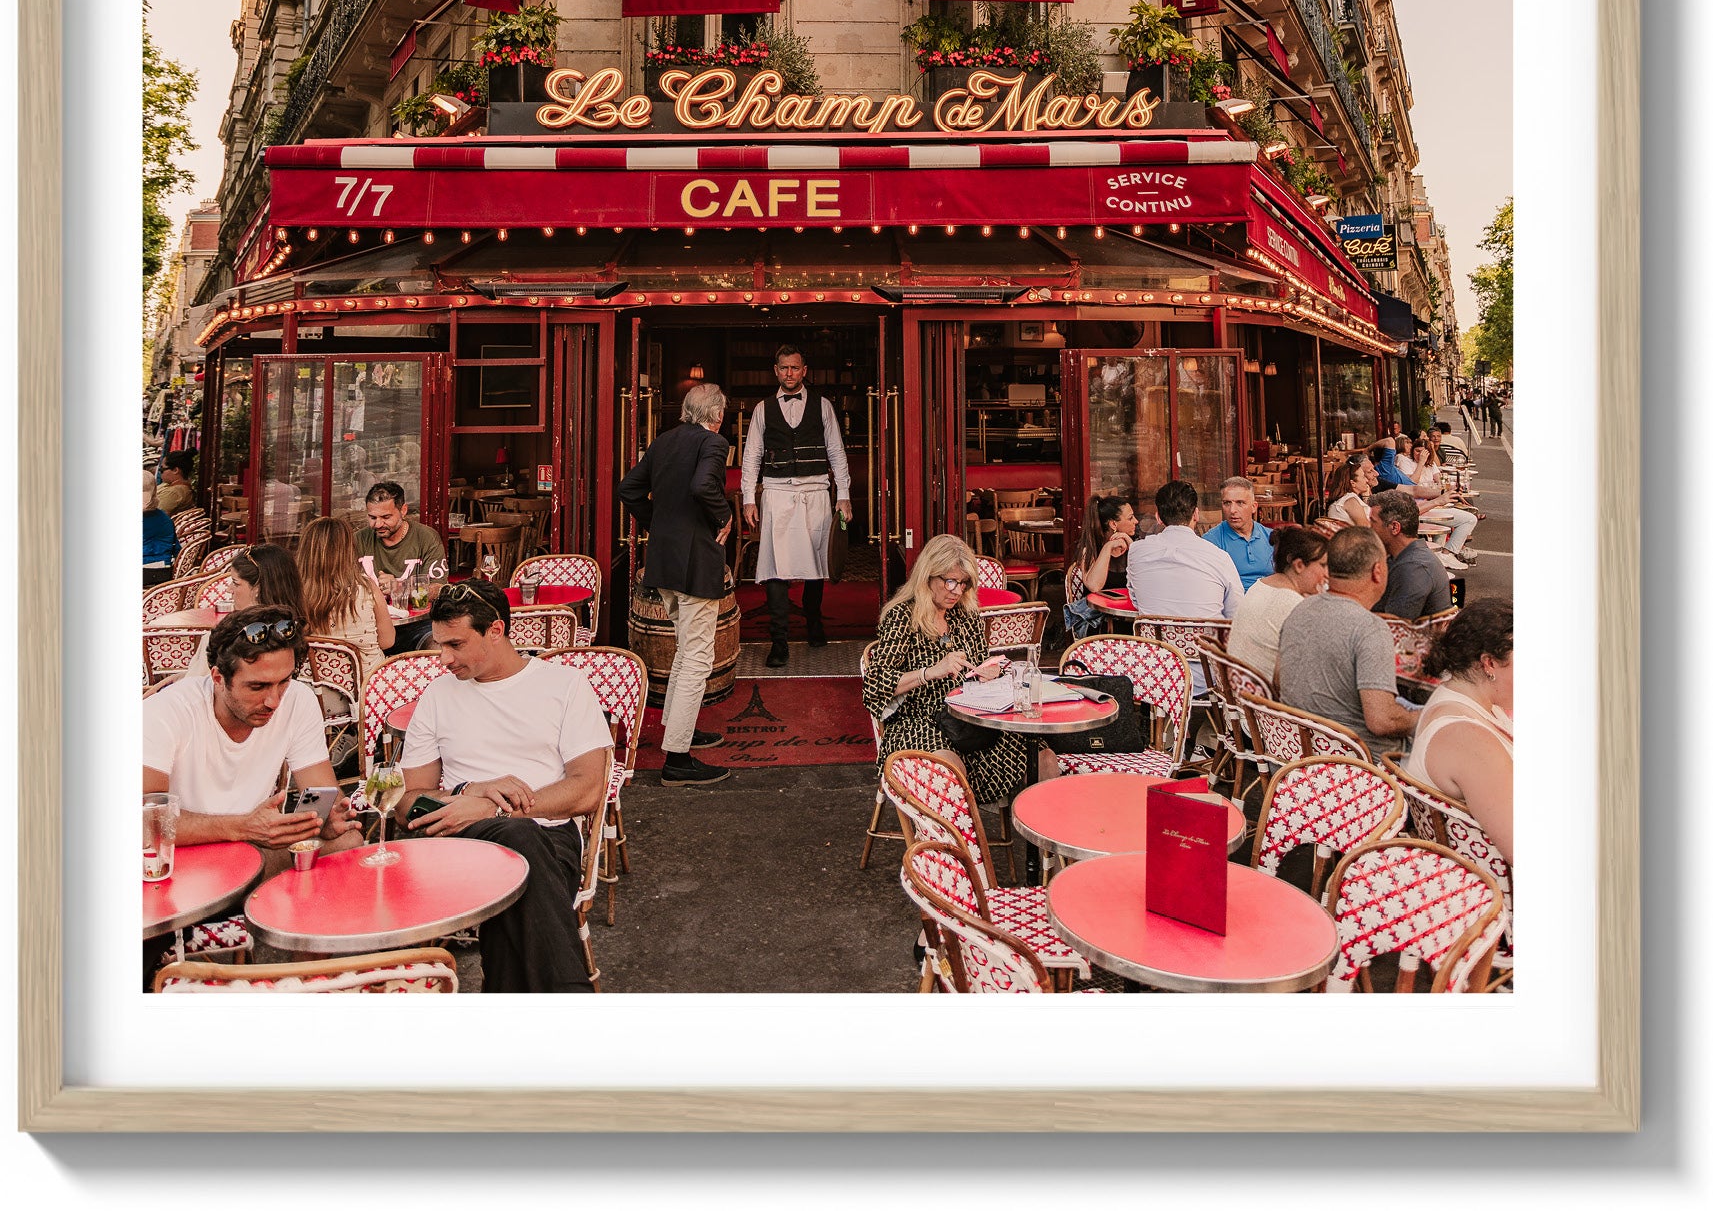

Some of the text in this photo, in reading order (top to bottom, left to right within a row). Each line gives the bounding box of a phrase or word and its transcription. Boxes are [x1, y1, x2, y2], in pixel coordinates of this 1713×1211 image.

[535, 67, 1161, 133] Le Champ de Mars
[1106, 172, 1188, 191] SERVICE
[335, 176, 394, 217] 7/7
[680, 178, 841, 218] CAFE
[1105, 195, 1193, 214] CONTINU
[1340, 223, 1381, 234] Pizzeria
[726, 725, 788, 734] BISTROT
[773, 735, 809, 747] de
[814, 733, 875, 746] Ma
